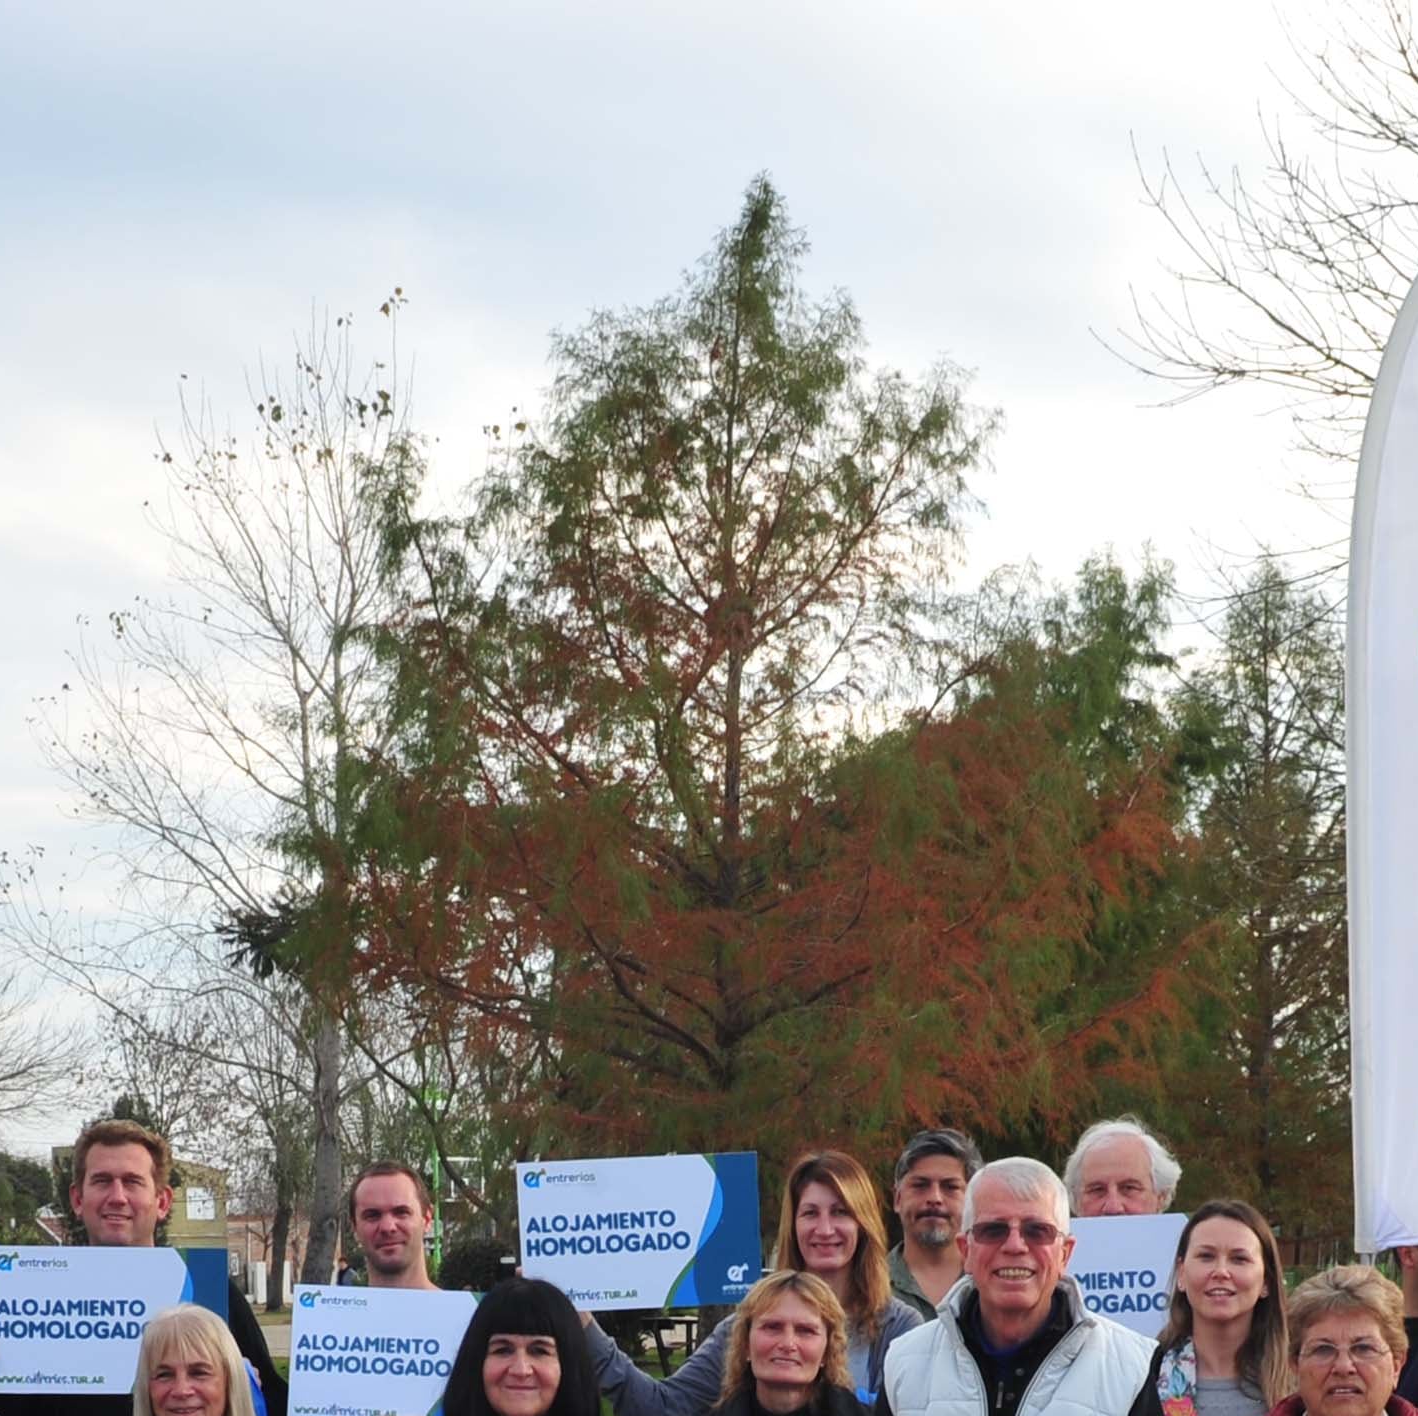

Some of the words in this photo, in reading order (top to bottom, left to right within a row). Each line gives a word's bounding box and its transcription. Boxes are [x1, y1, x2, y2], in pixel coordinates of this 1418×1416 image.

[526, 1209, 676, 1234] ALOJAMIENTO
[526, 1230, 691, 1257] HOMOLOGADO
[1074, 1270, 1157, 1291] MIENTO
[1083, 1291, 1171, 1314] OGADO
[297, 1334, 440, 1356] ALOJAMIENTO
[294, 1353, 452, 1377] HOMOLOGADO
